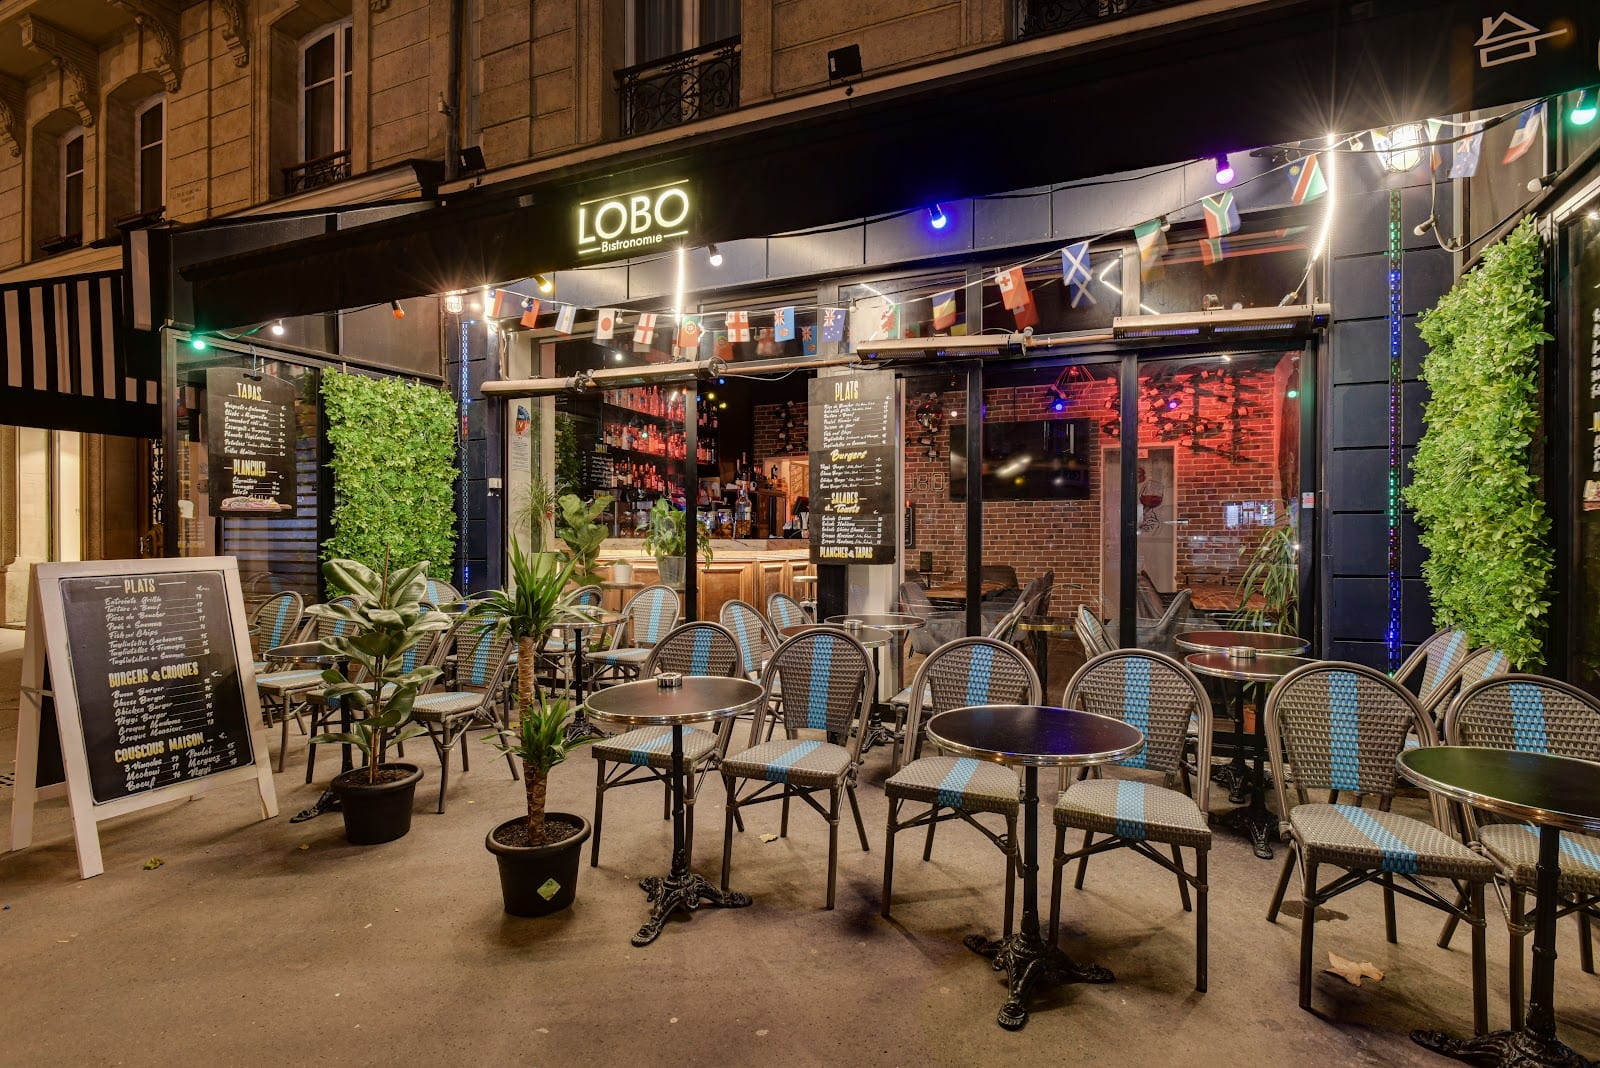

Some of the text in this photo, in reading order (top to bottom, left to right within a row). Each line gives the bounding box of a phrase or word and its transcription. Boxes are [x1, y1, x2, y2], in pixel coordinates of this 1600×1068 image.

[578, 188, 689, 245] LOBO
[602, 234, 663, 253] Bistronomie
[237, 383, 262, 401] TAPAS
[835, 380, 859, 402] PLATS
[830, 449, 868, 462] Burgers
[233, 459, 266, 477] PLANCHES
[832, 492, 859, 504] SALADES
[820, 546, 873, 558] PLANCHES & TAPAS
[124, 578, 156, 594] PLATS
[109, 631, 125, 639] Fish
[136, 629, 158, 638] Chips
[108, 668, 149, 688] BURGERS
[151, 671, 160, 682] &
[161, 662, 199, 680] CROQUES
[137, 687, 165, 696] Burger
[113, 698, 136, 708] Cheese
[139, 695, 165, 704] Burger
[115, 706, 144, 717] Chicken
[147, 703, 173, 712] Burger
[141, 712, 167, 722] Burger
[119, 725, 146, 736] Croque
[120, 733, 146, 744] Croque
[150, 726, 183, 736] Monsieur
[114, 732, 205, 763] COUSCOUS MAISON
[186, 746, 213, 759] Poulet
[124, 764, 130, 772] 3
[131, 758, 162, 770] Viandes
[188, 755, 221, 768] Merguez
